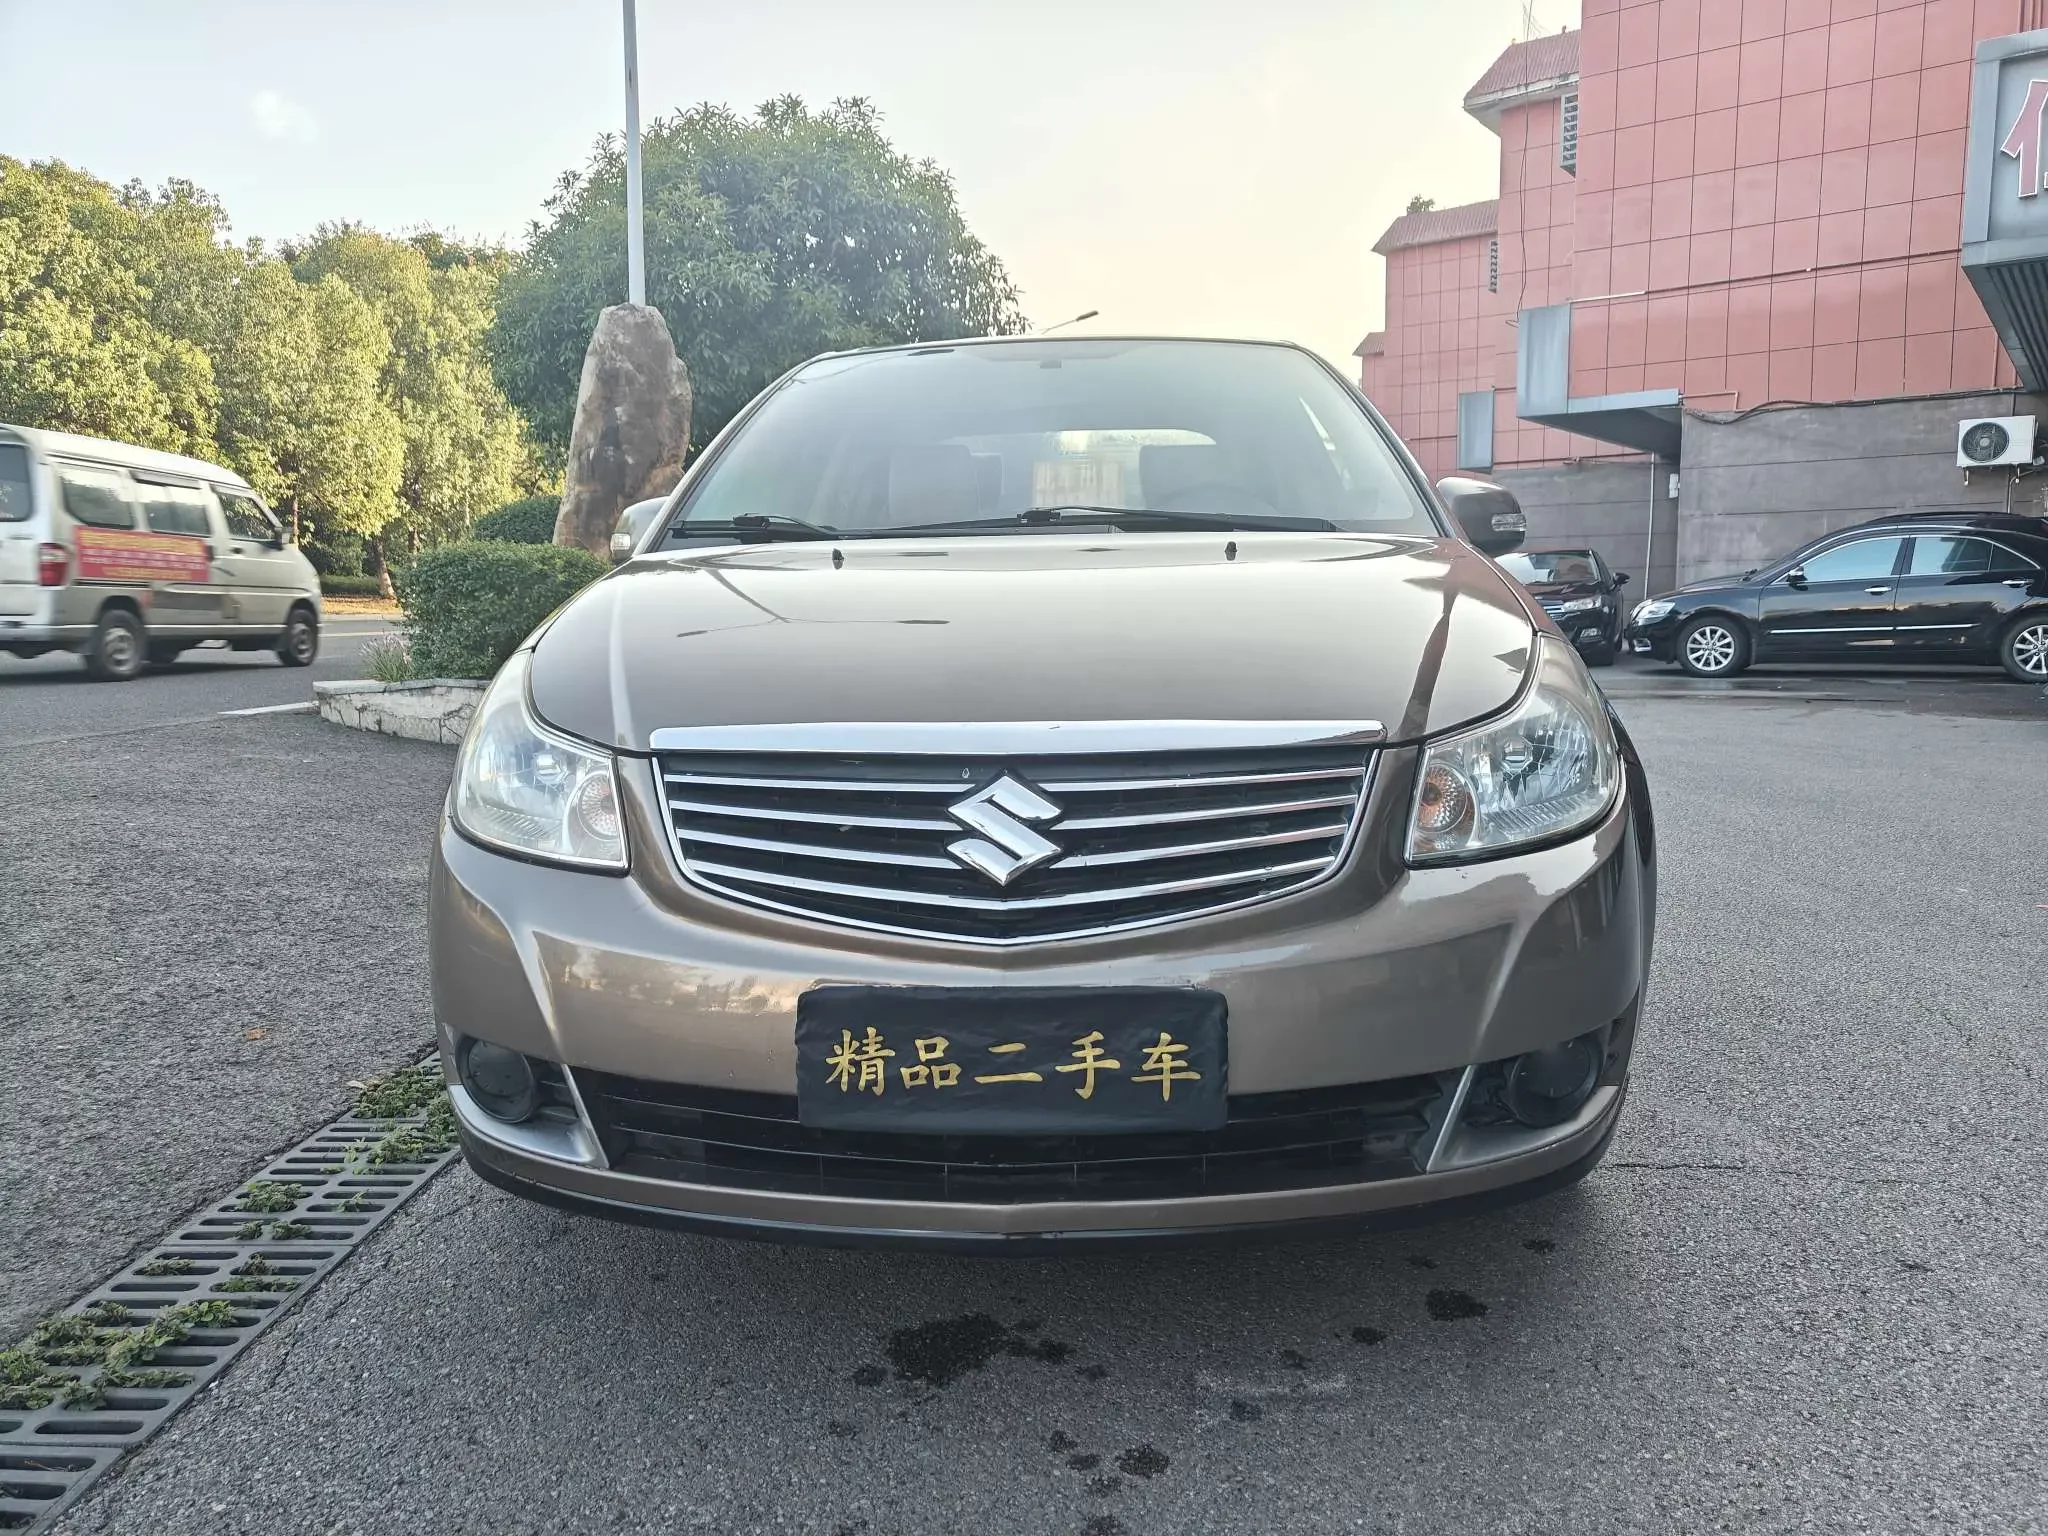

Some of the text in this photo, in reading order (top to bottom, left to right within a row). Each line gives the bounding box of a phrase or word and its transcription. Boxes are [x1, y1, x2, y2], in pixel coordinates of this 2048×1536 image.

[825, 1026, 1201, 1102] 精品二手车
